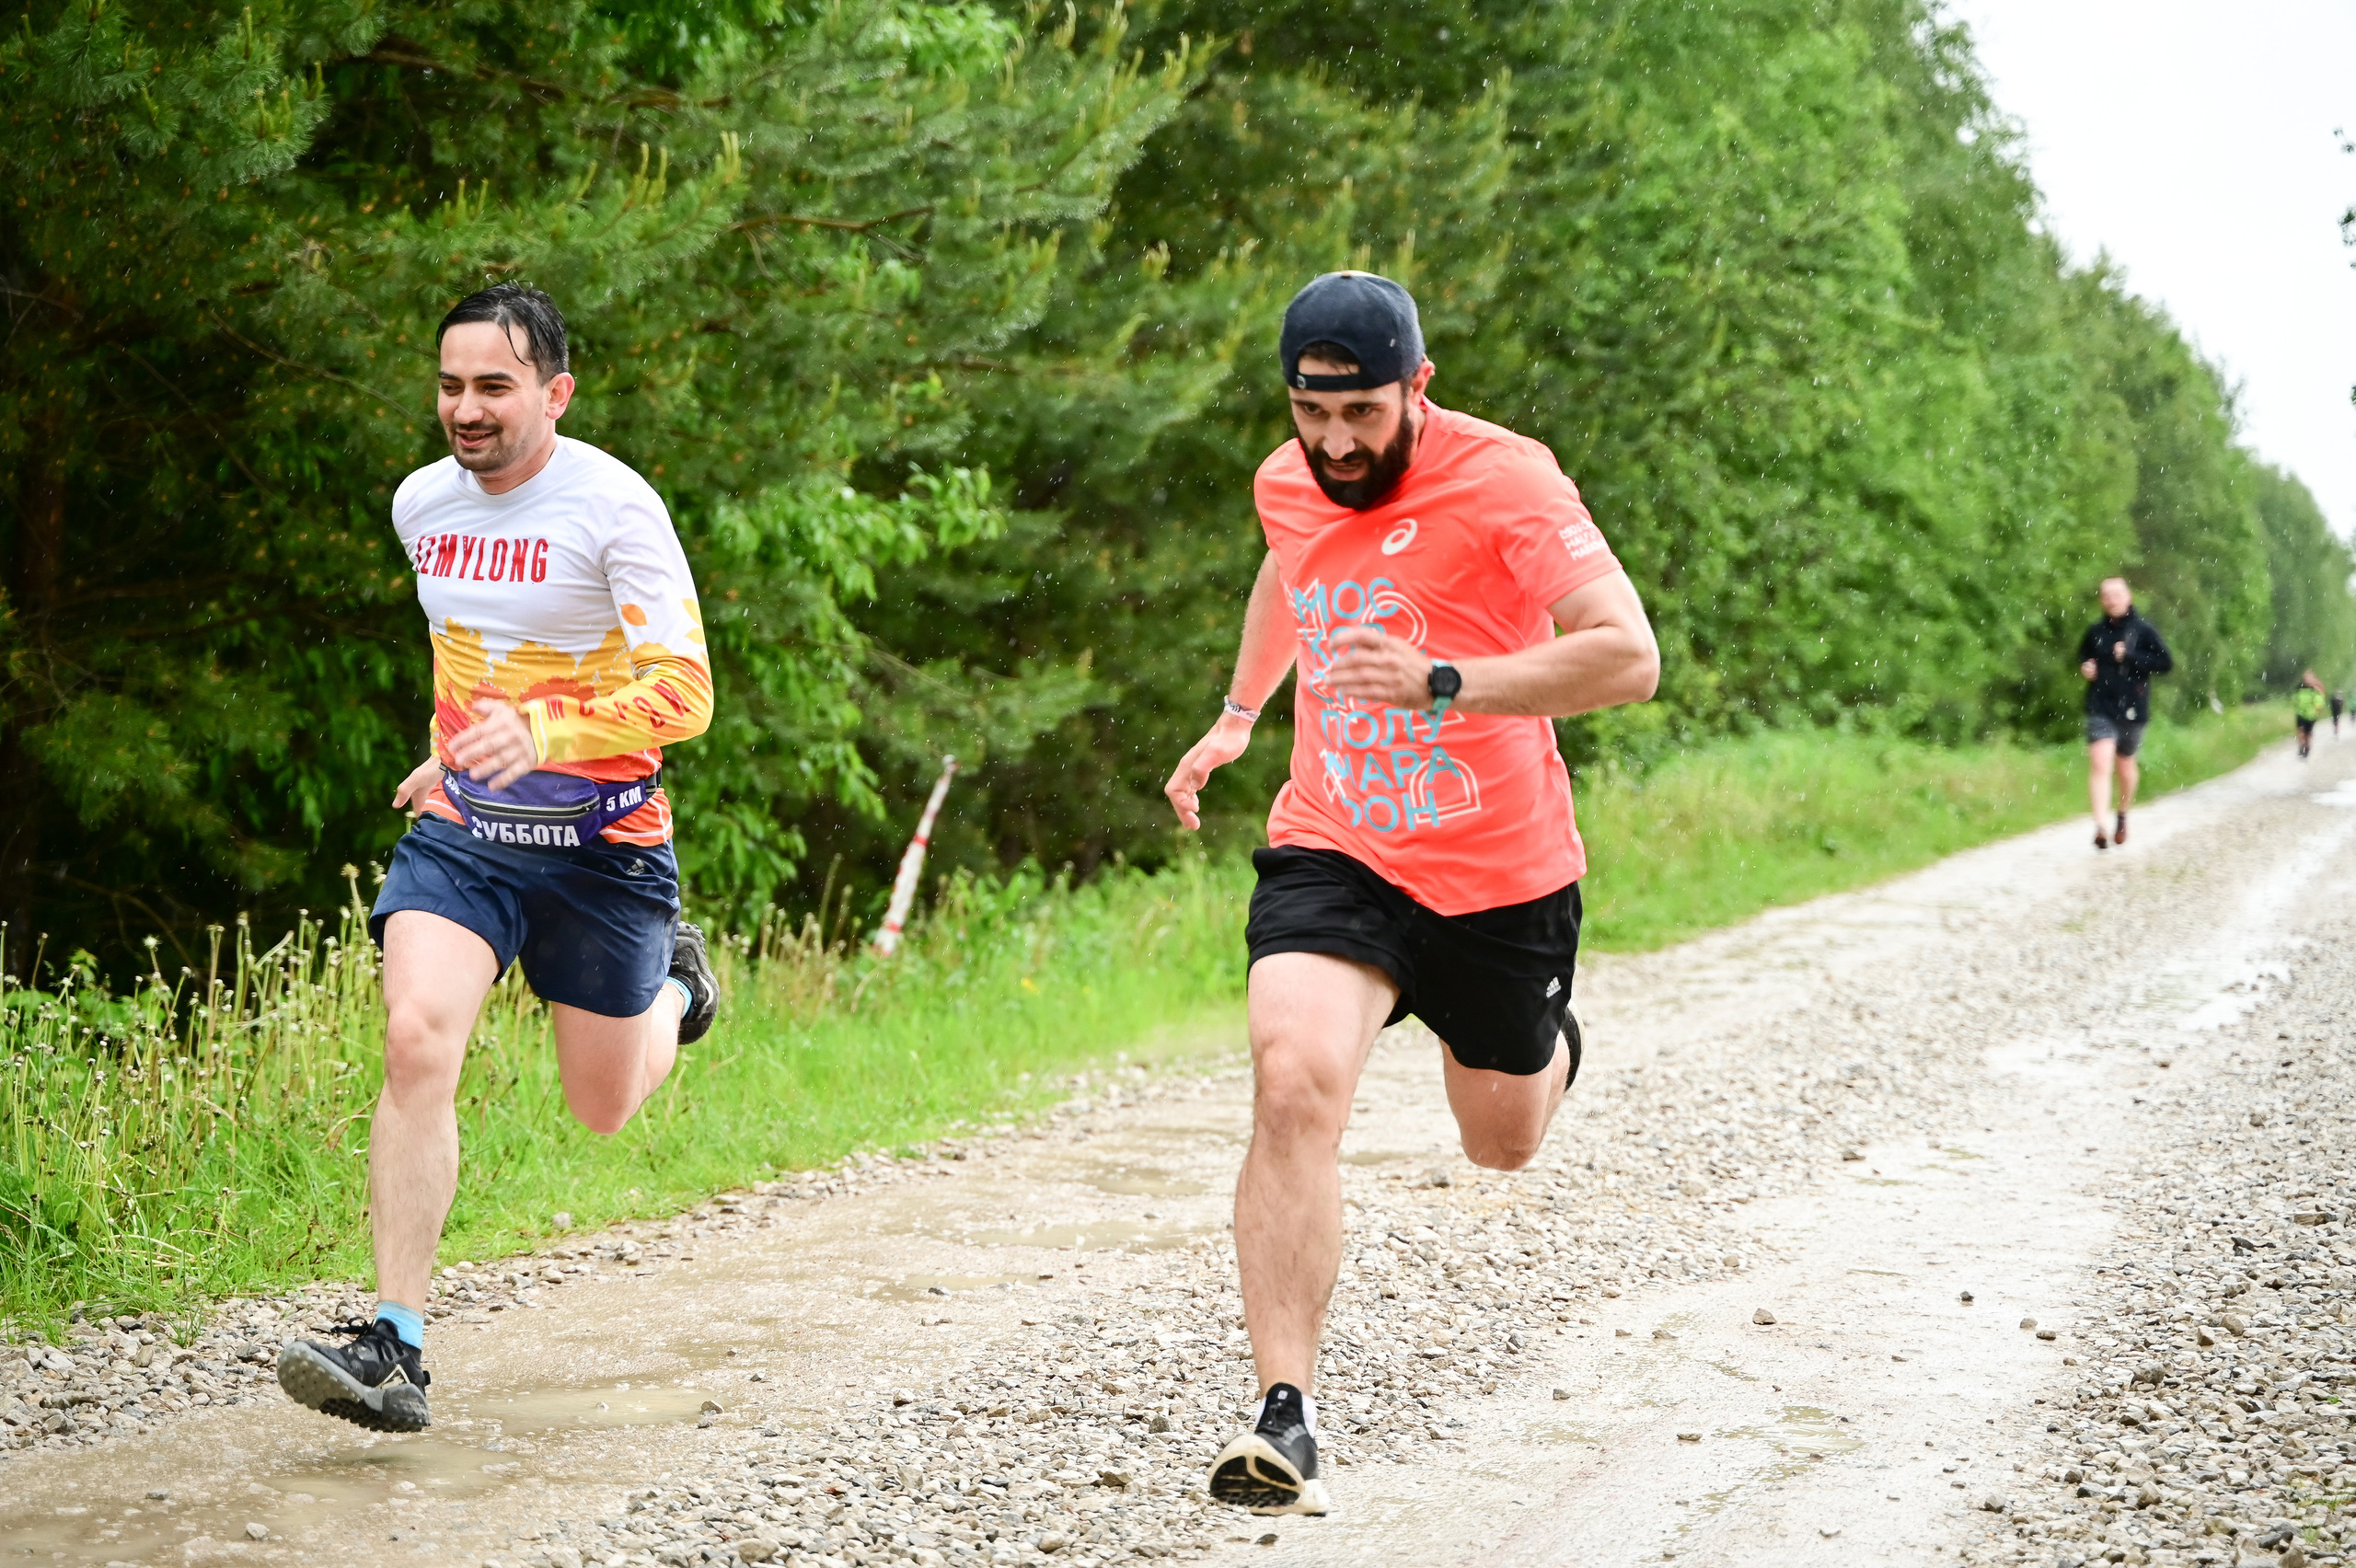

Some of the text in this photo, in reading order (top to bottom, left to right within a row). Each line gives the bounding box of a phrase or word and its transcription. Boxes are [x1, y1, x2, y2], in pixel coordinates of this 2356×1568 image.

[415, 533, 549, 582] IZMYLONG
[1293, 577, 1399, 624] МОС
[1321, 708, 1448, 749] ПОЛУ
[606, 795, 617, 812] 5
[471, 815, 582, 847] СУББОТА
